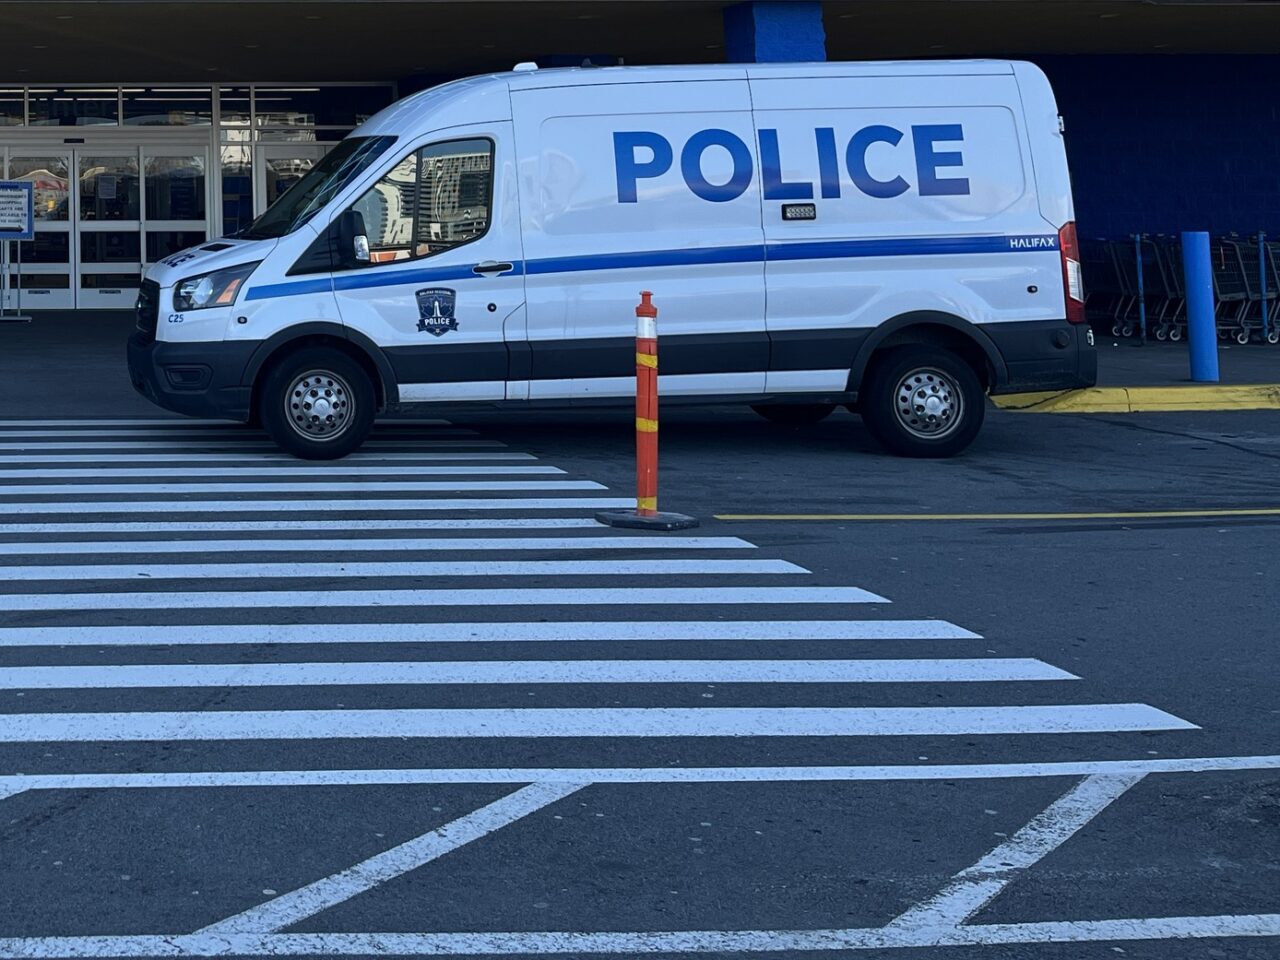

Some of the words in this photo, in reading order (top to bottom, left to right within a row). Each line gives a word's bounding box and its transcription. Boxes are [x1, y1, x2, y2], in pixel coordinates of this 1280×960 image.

[613, 124, 970, 203] POLICE
[1010, 237, 1055, 248] HALIFAX
[168, 314, 184, 323] C25
[424, 317, 450, 326] POLICE
